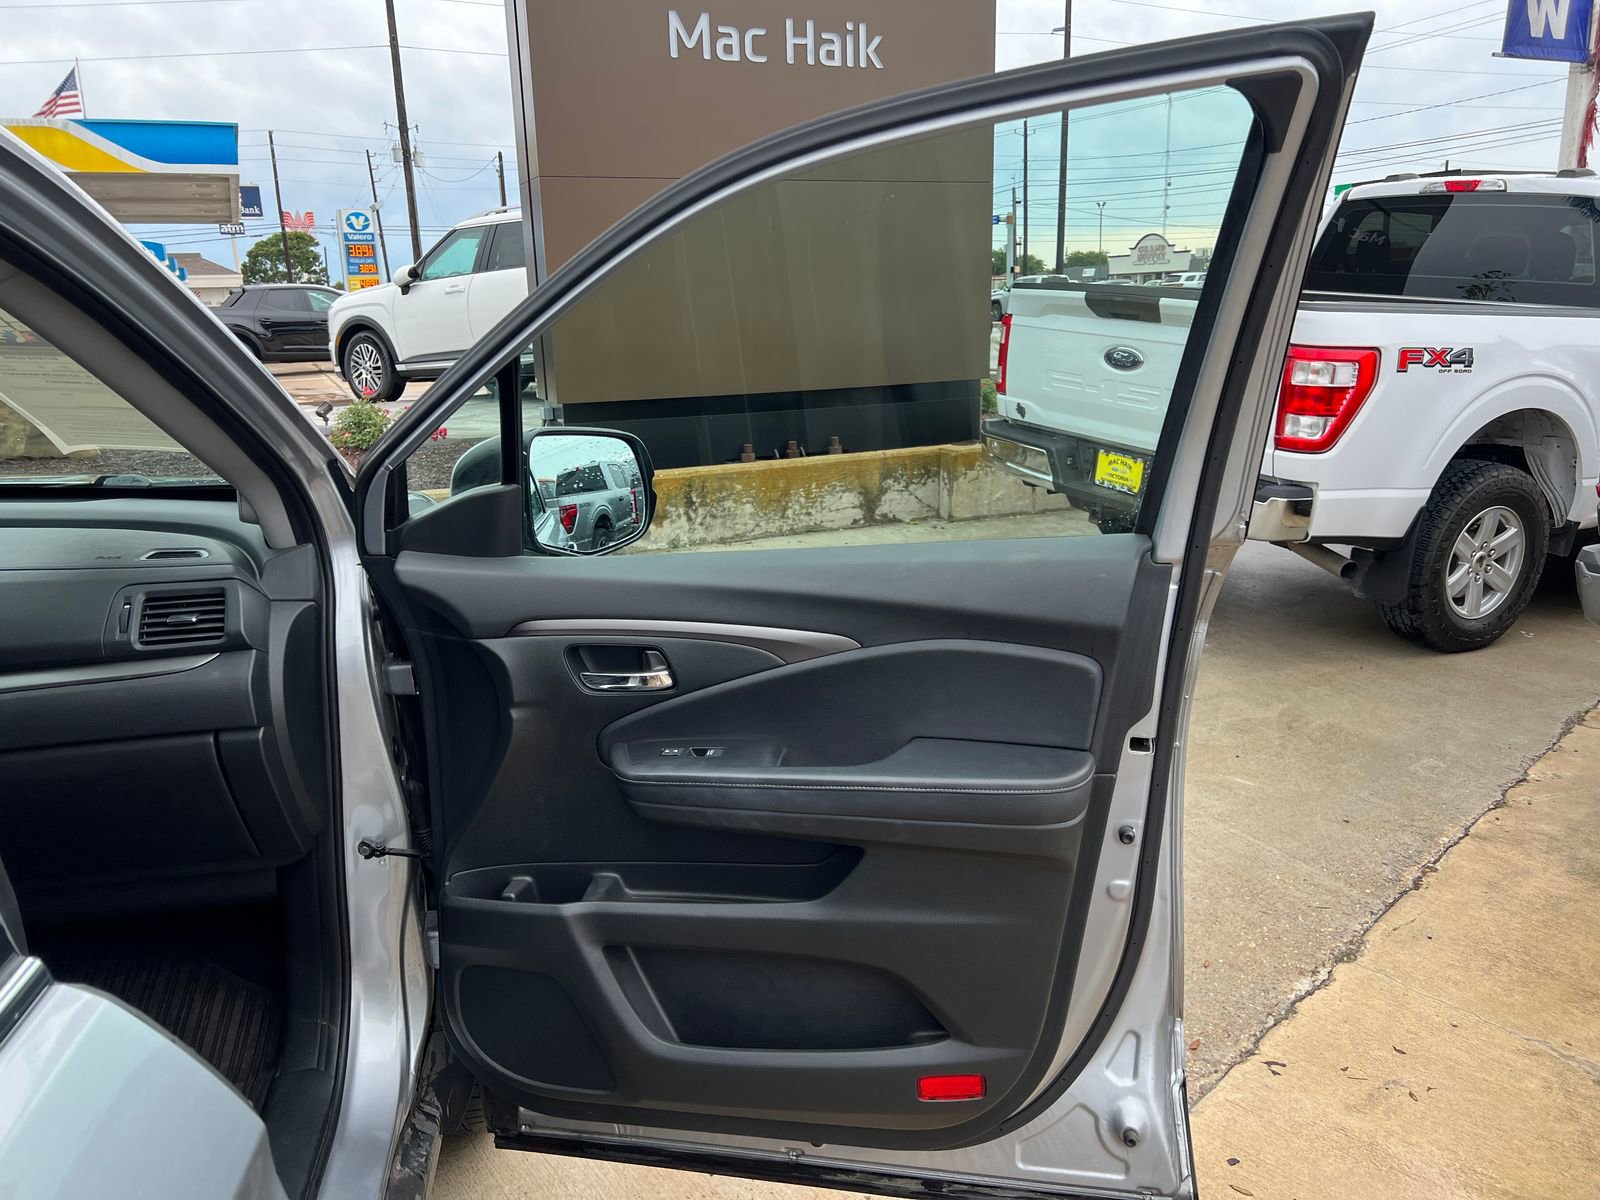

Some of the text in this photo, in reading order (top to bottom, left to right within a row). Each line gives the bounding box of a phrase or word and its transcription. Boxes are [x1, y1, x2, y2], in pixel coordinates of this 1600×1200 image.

[1527, 0, 1570, 40] W
[668, 9, 884, 69] Mac Haik
[220, 223, 244, 233] atm
[1397, 347, 1474, 373] FX4
